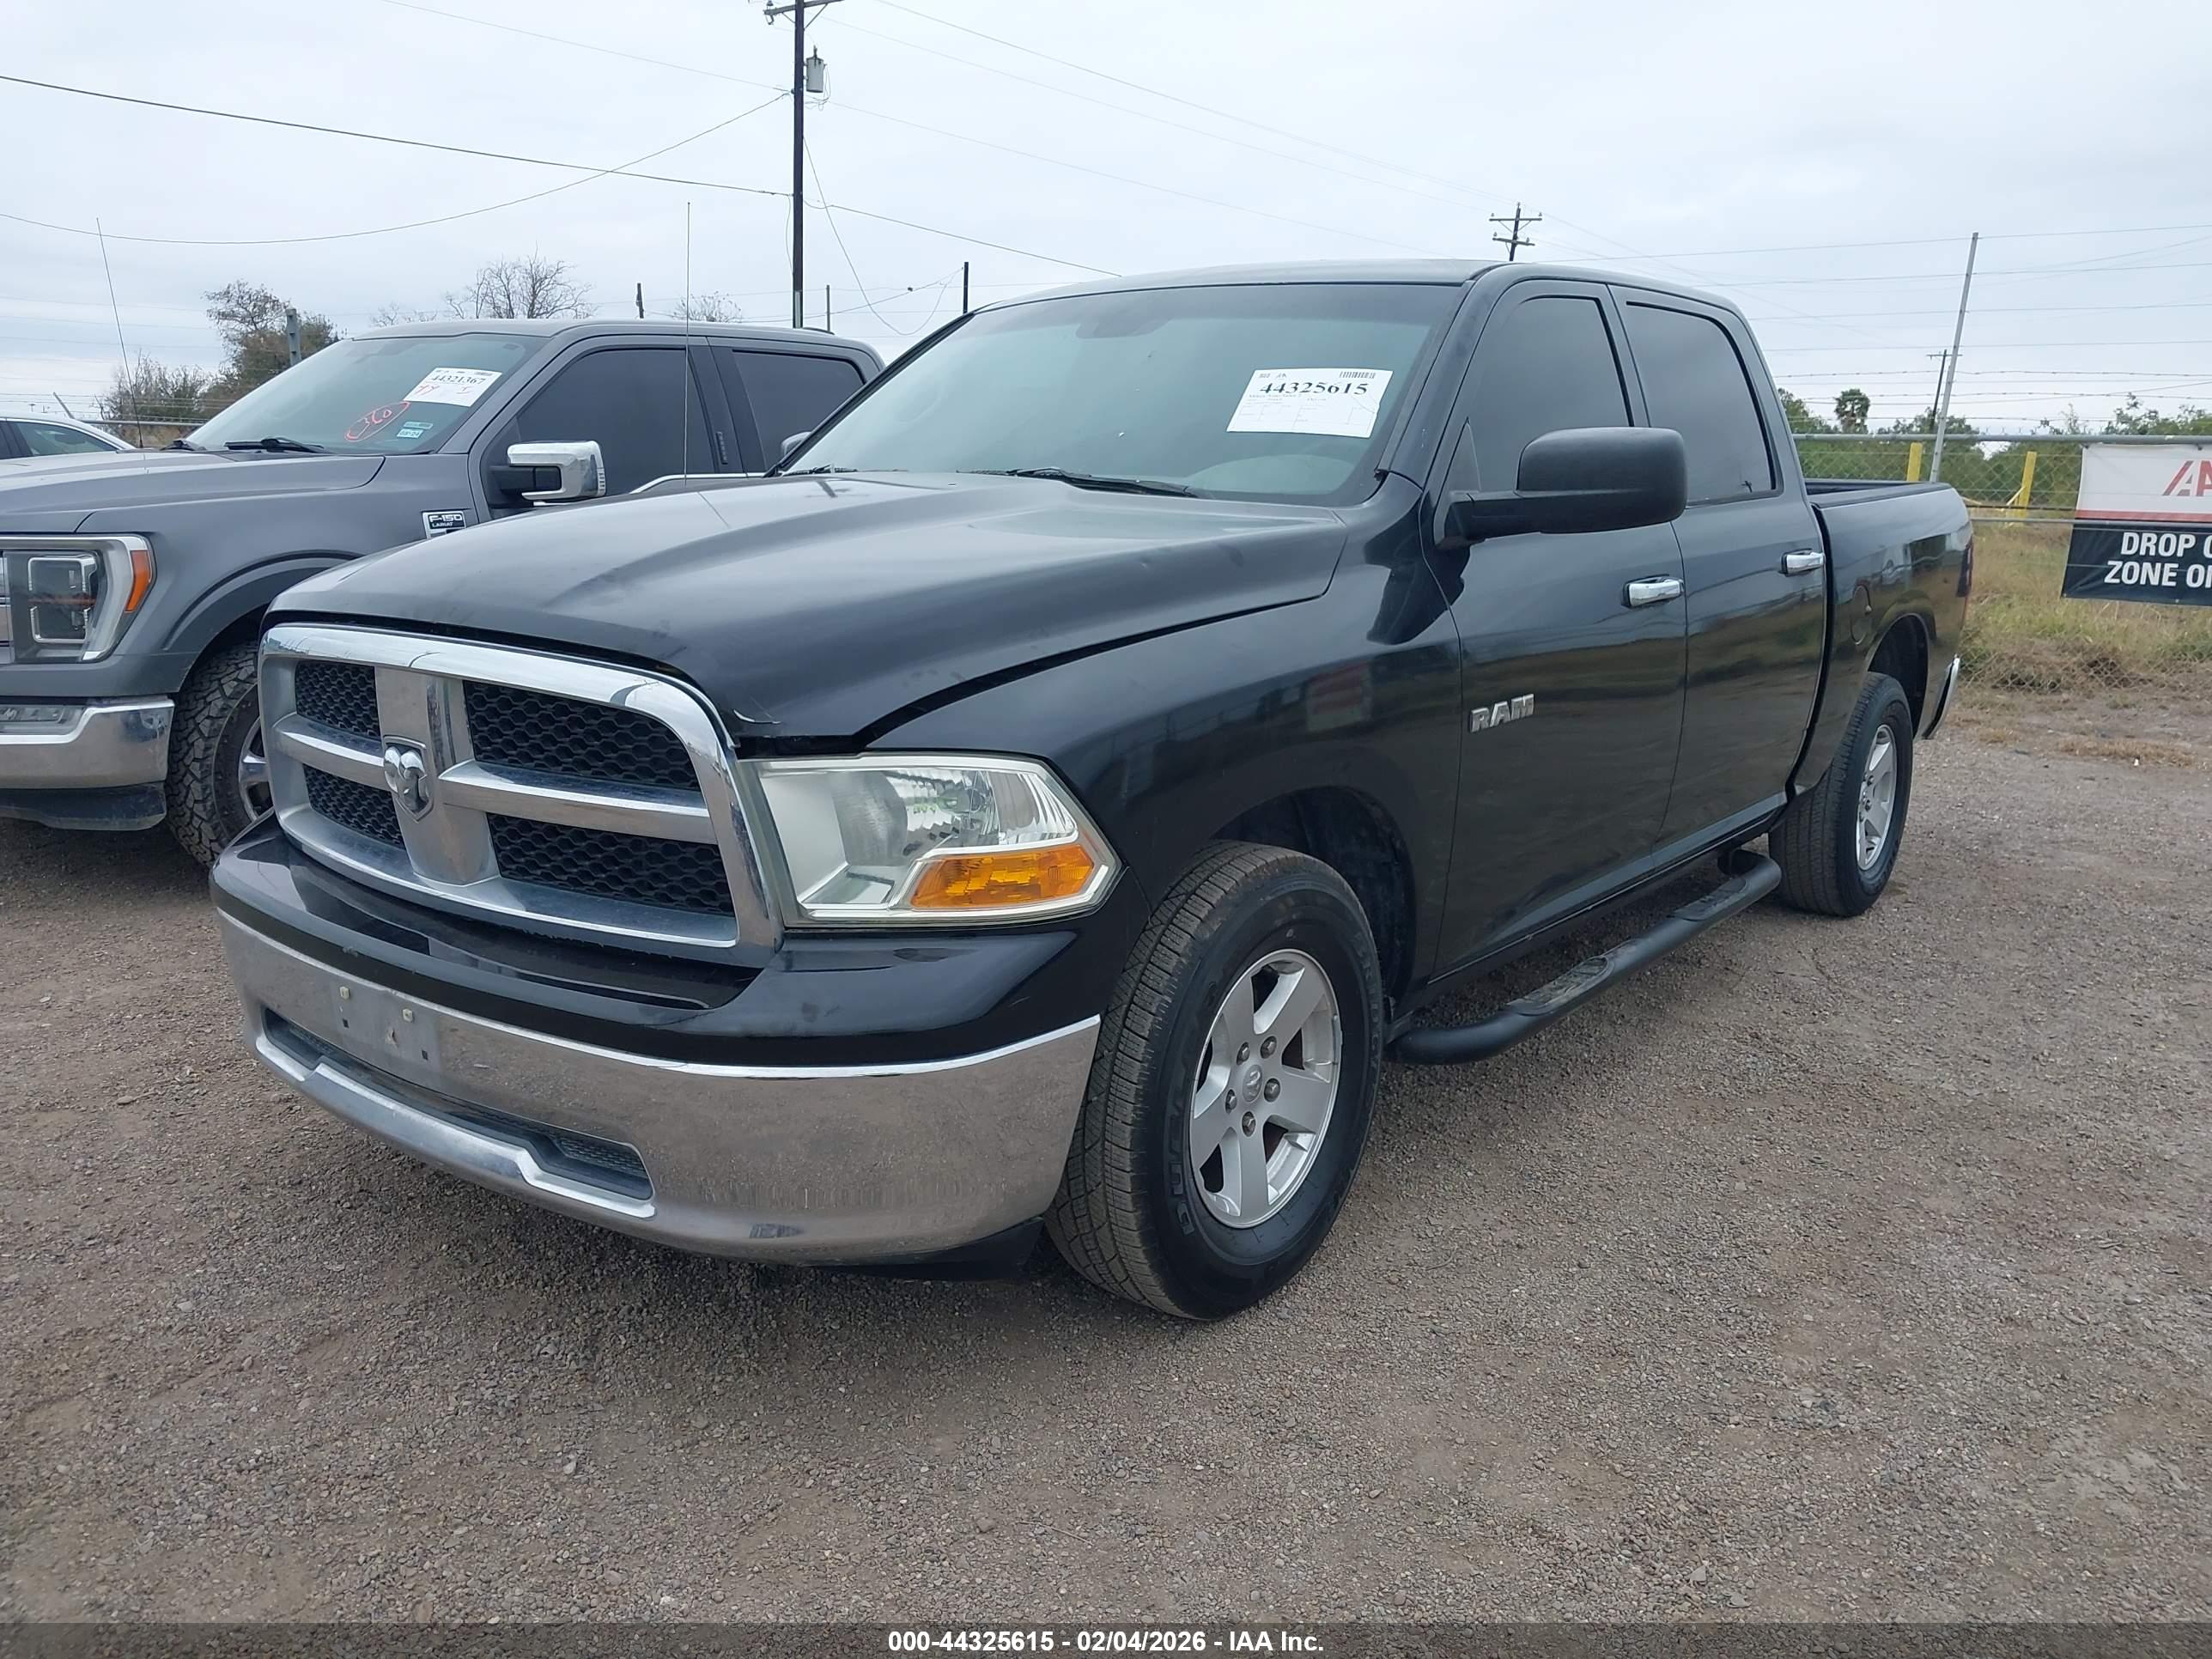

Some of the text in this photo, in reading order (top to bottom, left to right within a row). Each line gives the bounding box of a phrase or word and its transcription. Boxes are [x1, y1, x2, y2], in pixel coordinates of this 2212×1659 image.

[1259, 381, 1369, 395] 44325615
[428, 514, 463, 522] F-150
[2121, 532, 2197, 557] DROP
[2104, 561, 2179, 586] ZONE
[1470, 693, 1534, 732] RAM
